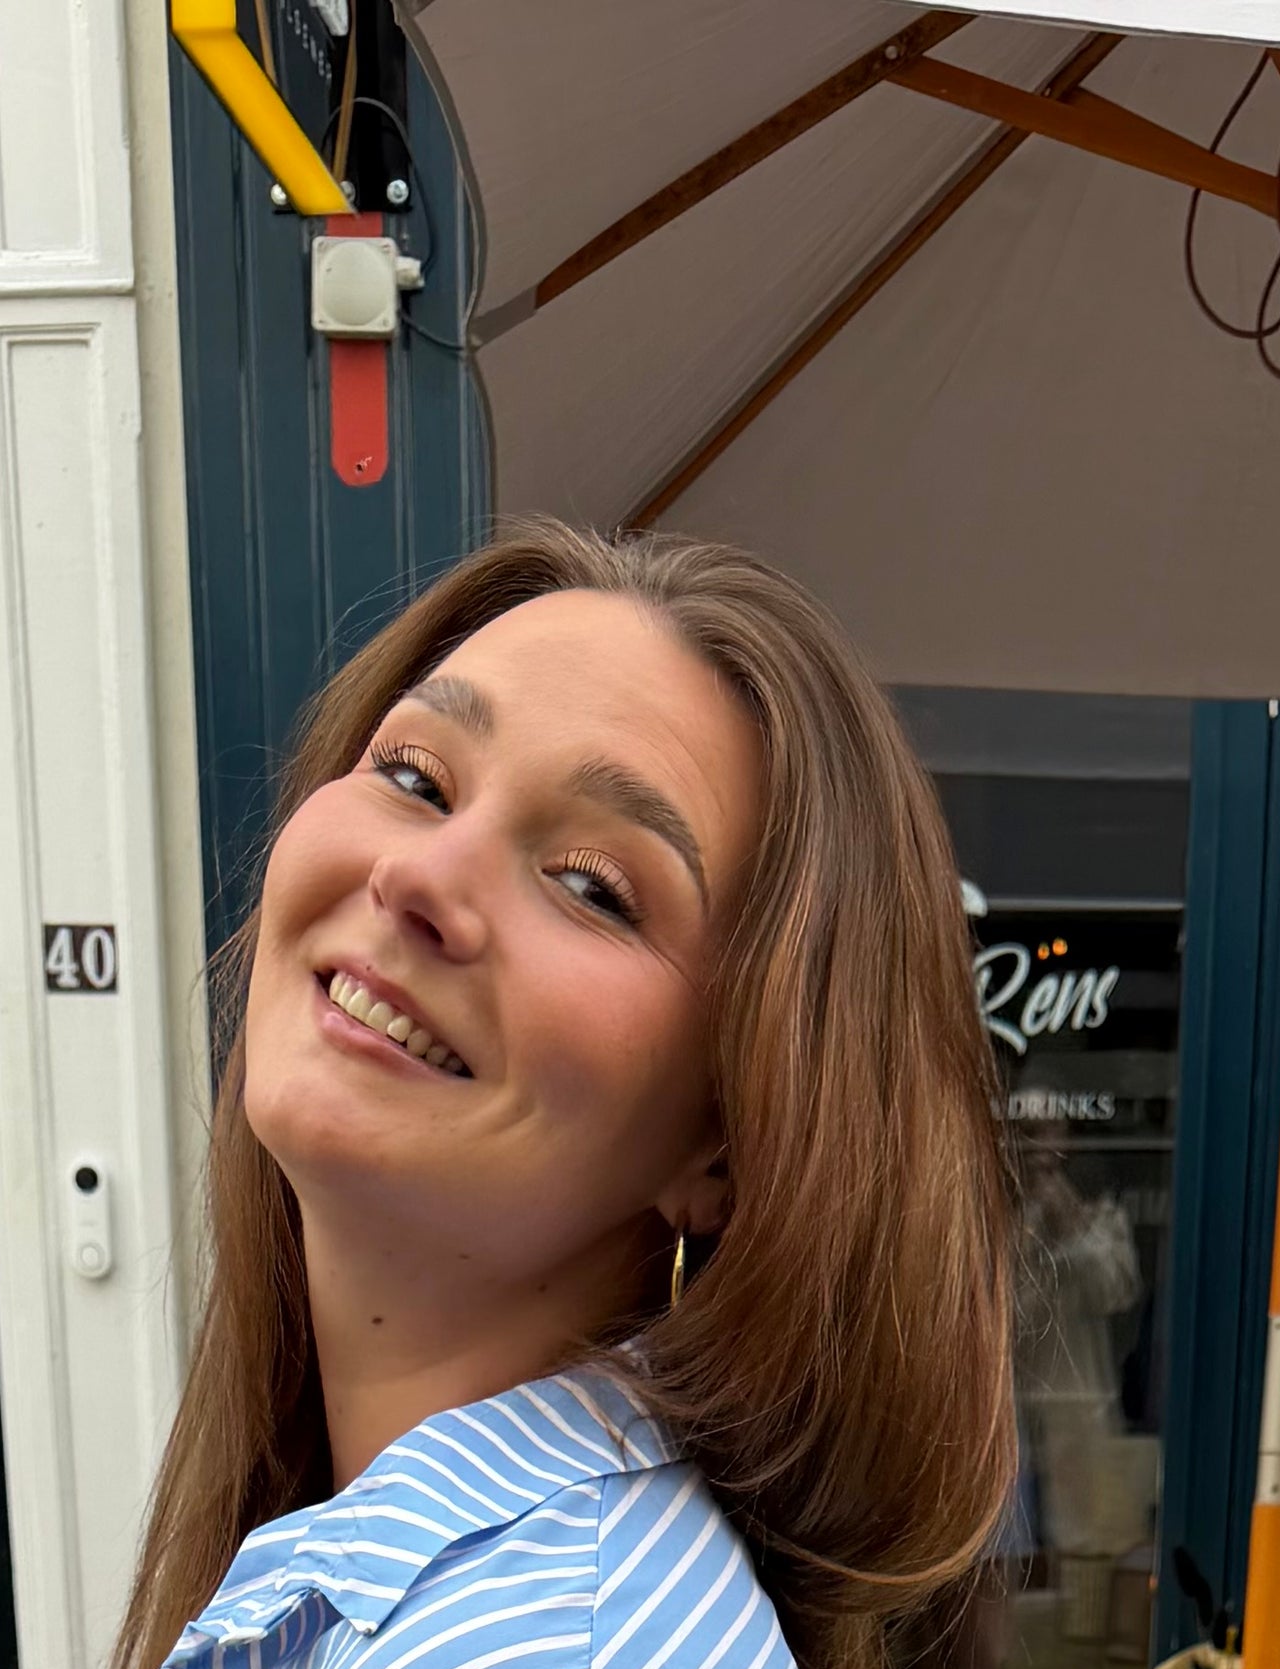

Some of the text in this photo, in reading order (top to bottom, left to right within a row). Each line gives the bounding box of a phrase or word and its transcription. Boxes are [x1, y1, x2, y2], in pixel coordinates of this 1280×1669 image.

[46, 927, 115, 988] 40
[972, 941, 1119, 1056] Rens
[1008, 1090, 1116, 1120] DRINKS
